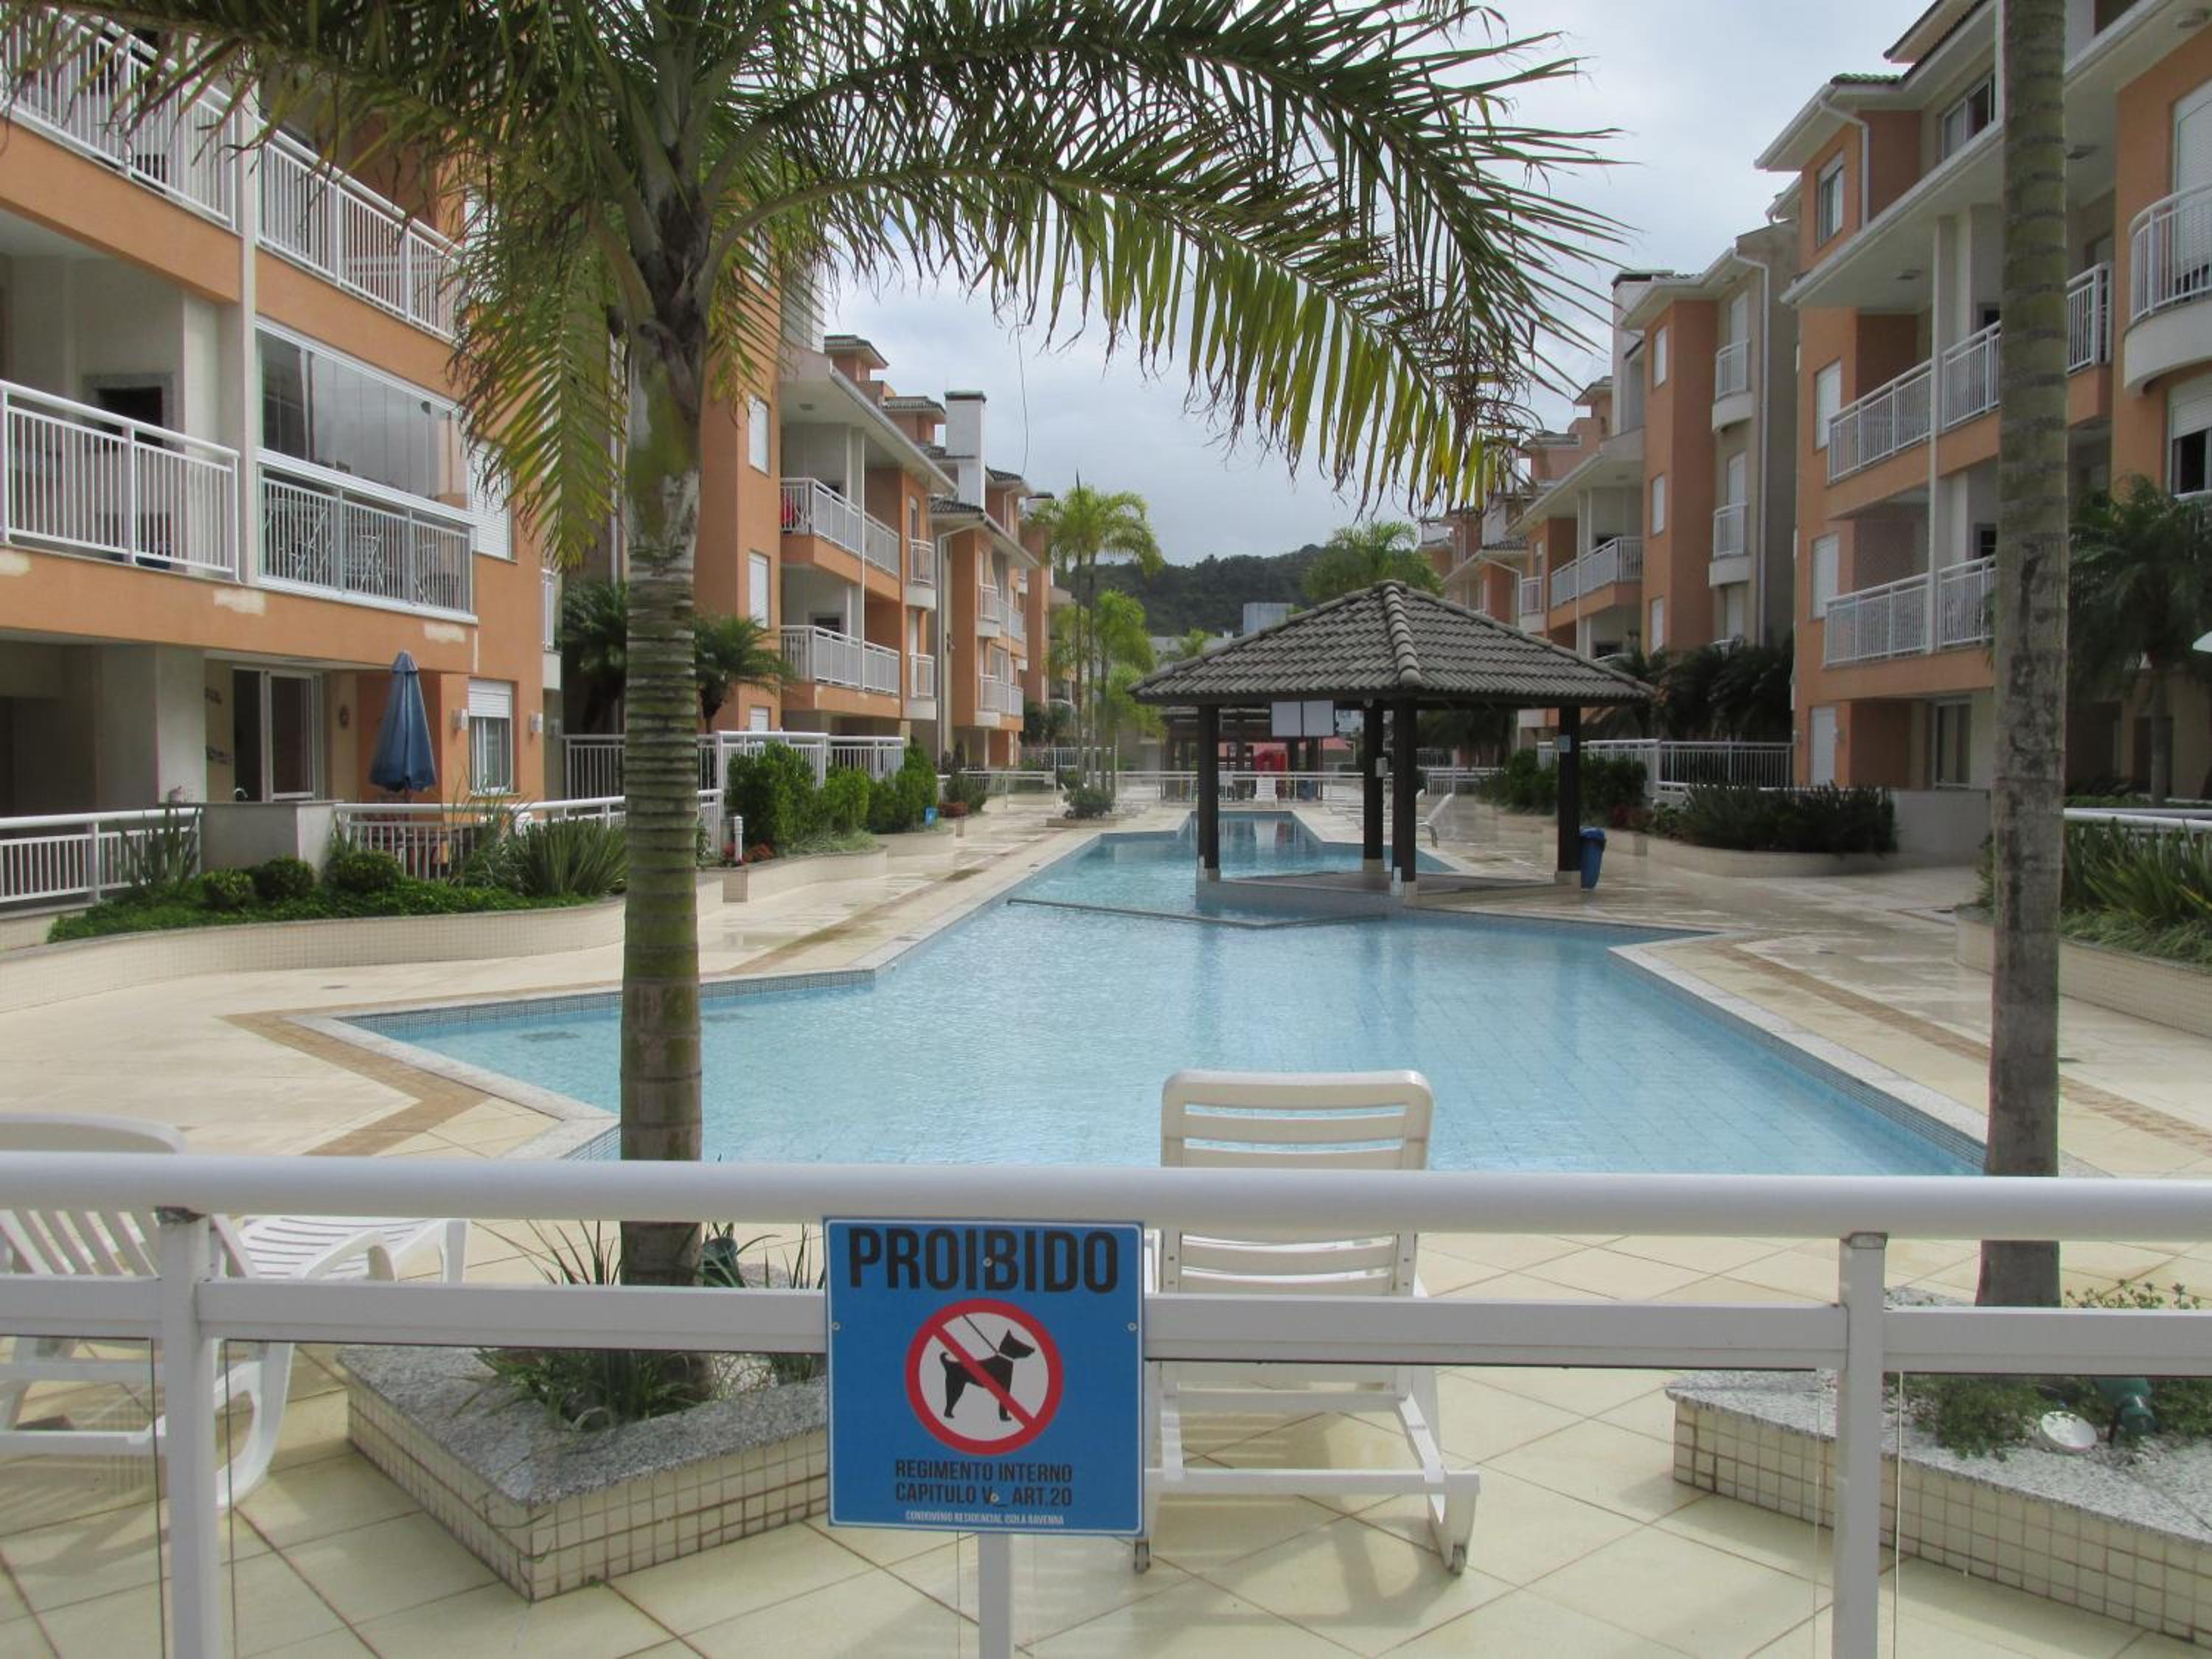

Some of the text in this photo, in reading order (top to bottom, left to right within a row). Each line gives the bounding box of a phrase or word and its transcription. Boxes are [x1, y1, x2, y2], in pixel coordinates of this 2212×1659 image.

[849, 1227, 1119, 1293] PROIBIDO
[896, 1460, 1073, 1483] REGIMENTO INTERNO
[896, 1483, 976, 1503] CAPITULO
[1013, 1486, 1073, 1506] ART.20
